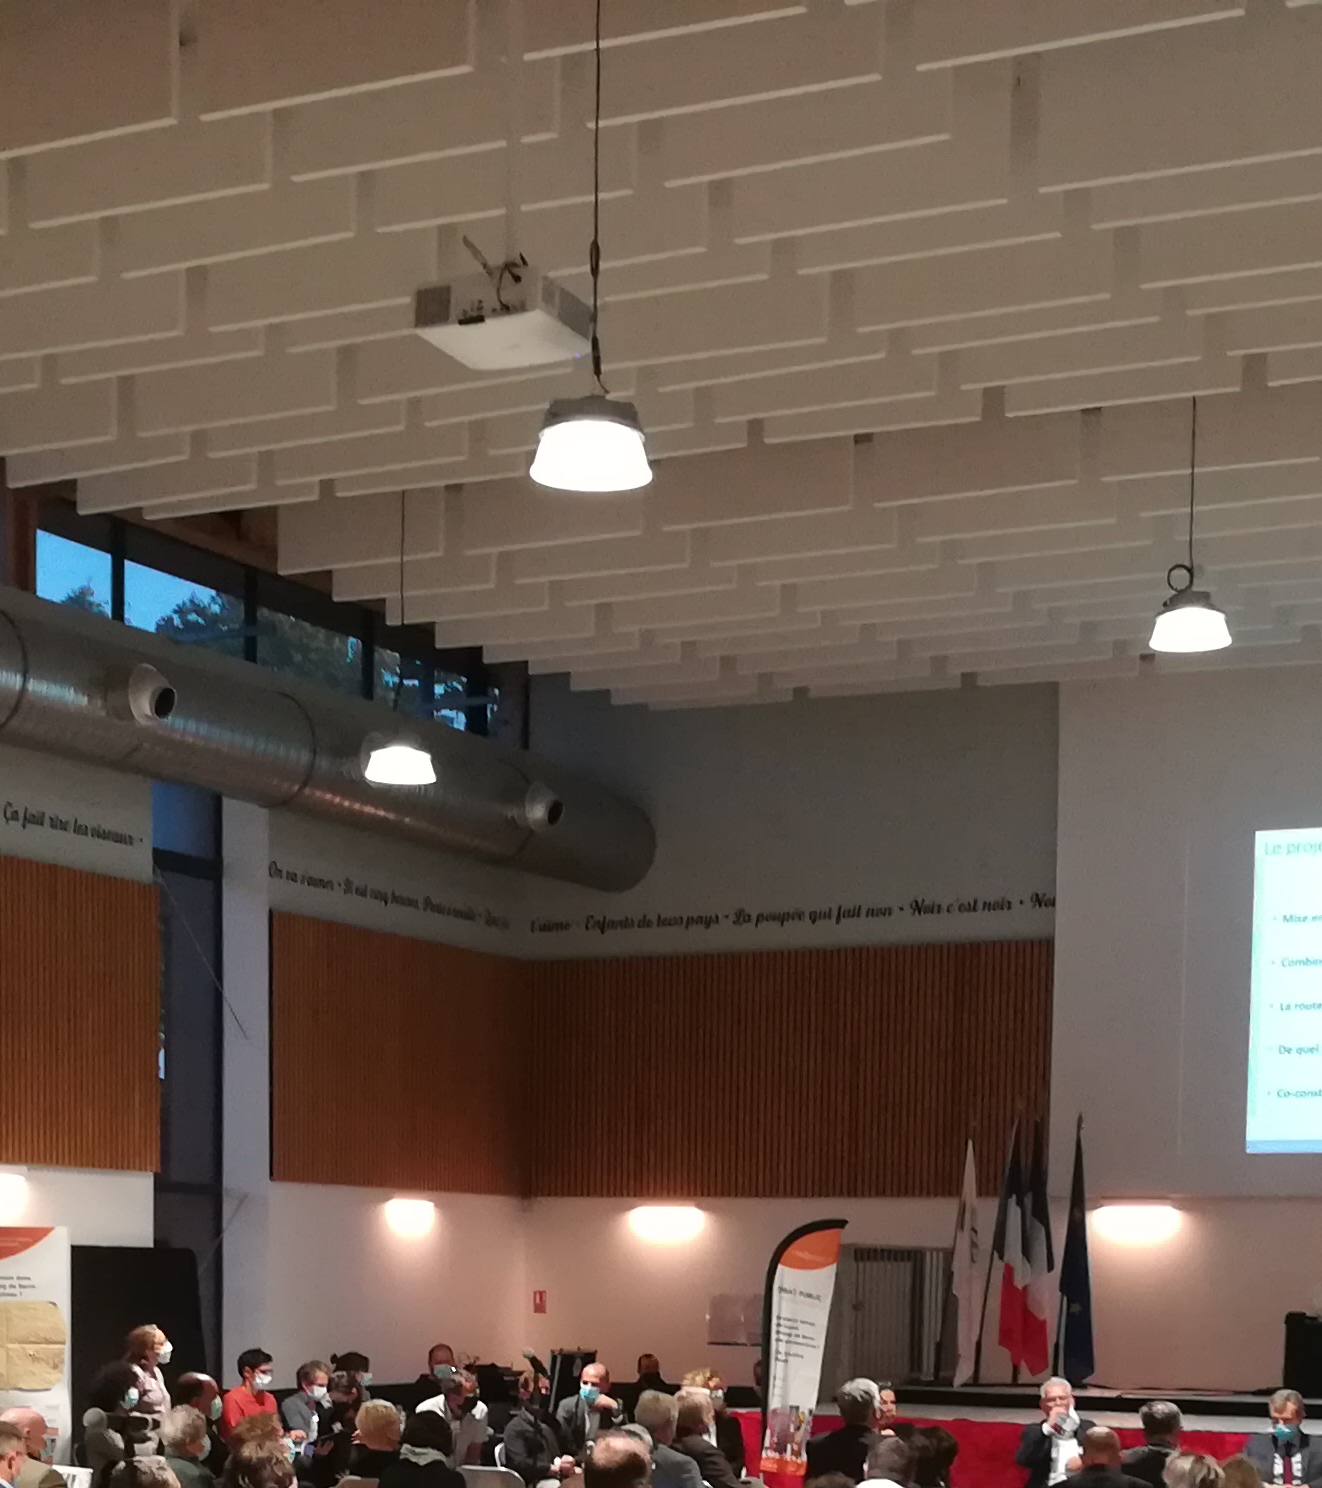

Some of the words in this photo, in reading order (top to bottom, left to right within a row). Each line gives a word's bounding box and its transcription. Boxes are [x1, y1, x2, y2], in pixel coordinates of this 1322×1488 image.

[3, 800, 20, 825] Ça
[22, 806, 46, 831] fait
[73, 817, 89, 837] les
[1264, 842, 1282, 856] Le
[584, 914, 636, 935] Enfants
[637, 913, 654, 929] de
[685, 913, 720, 931] pays
[732, 907, 752, 926] La
[755, 907, 806, 928] poupée
[808, 905, 833, 926] qui
[835, 903, 862, 925] fait
[864, 903, 894, 919] non
[910, 898, 942, 916] Noir
[945, 898, 978, 915] c'est
[981, 898, 1014, 914] noir
[1283, 912, 1308, 923] Mise
[1280, 1002, 1291, 1012] La
[1294, 1001, 1322, 1011] route
[1278, 1044, 1293, 1055] De
[1296, 1043, 1319, 1057] quel
